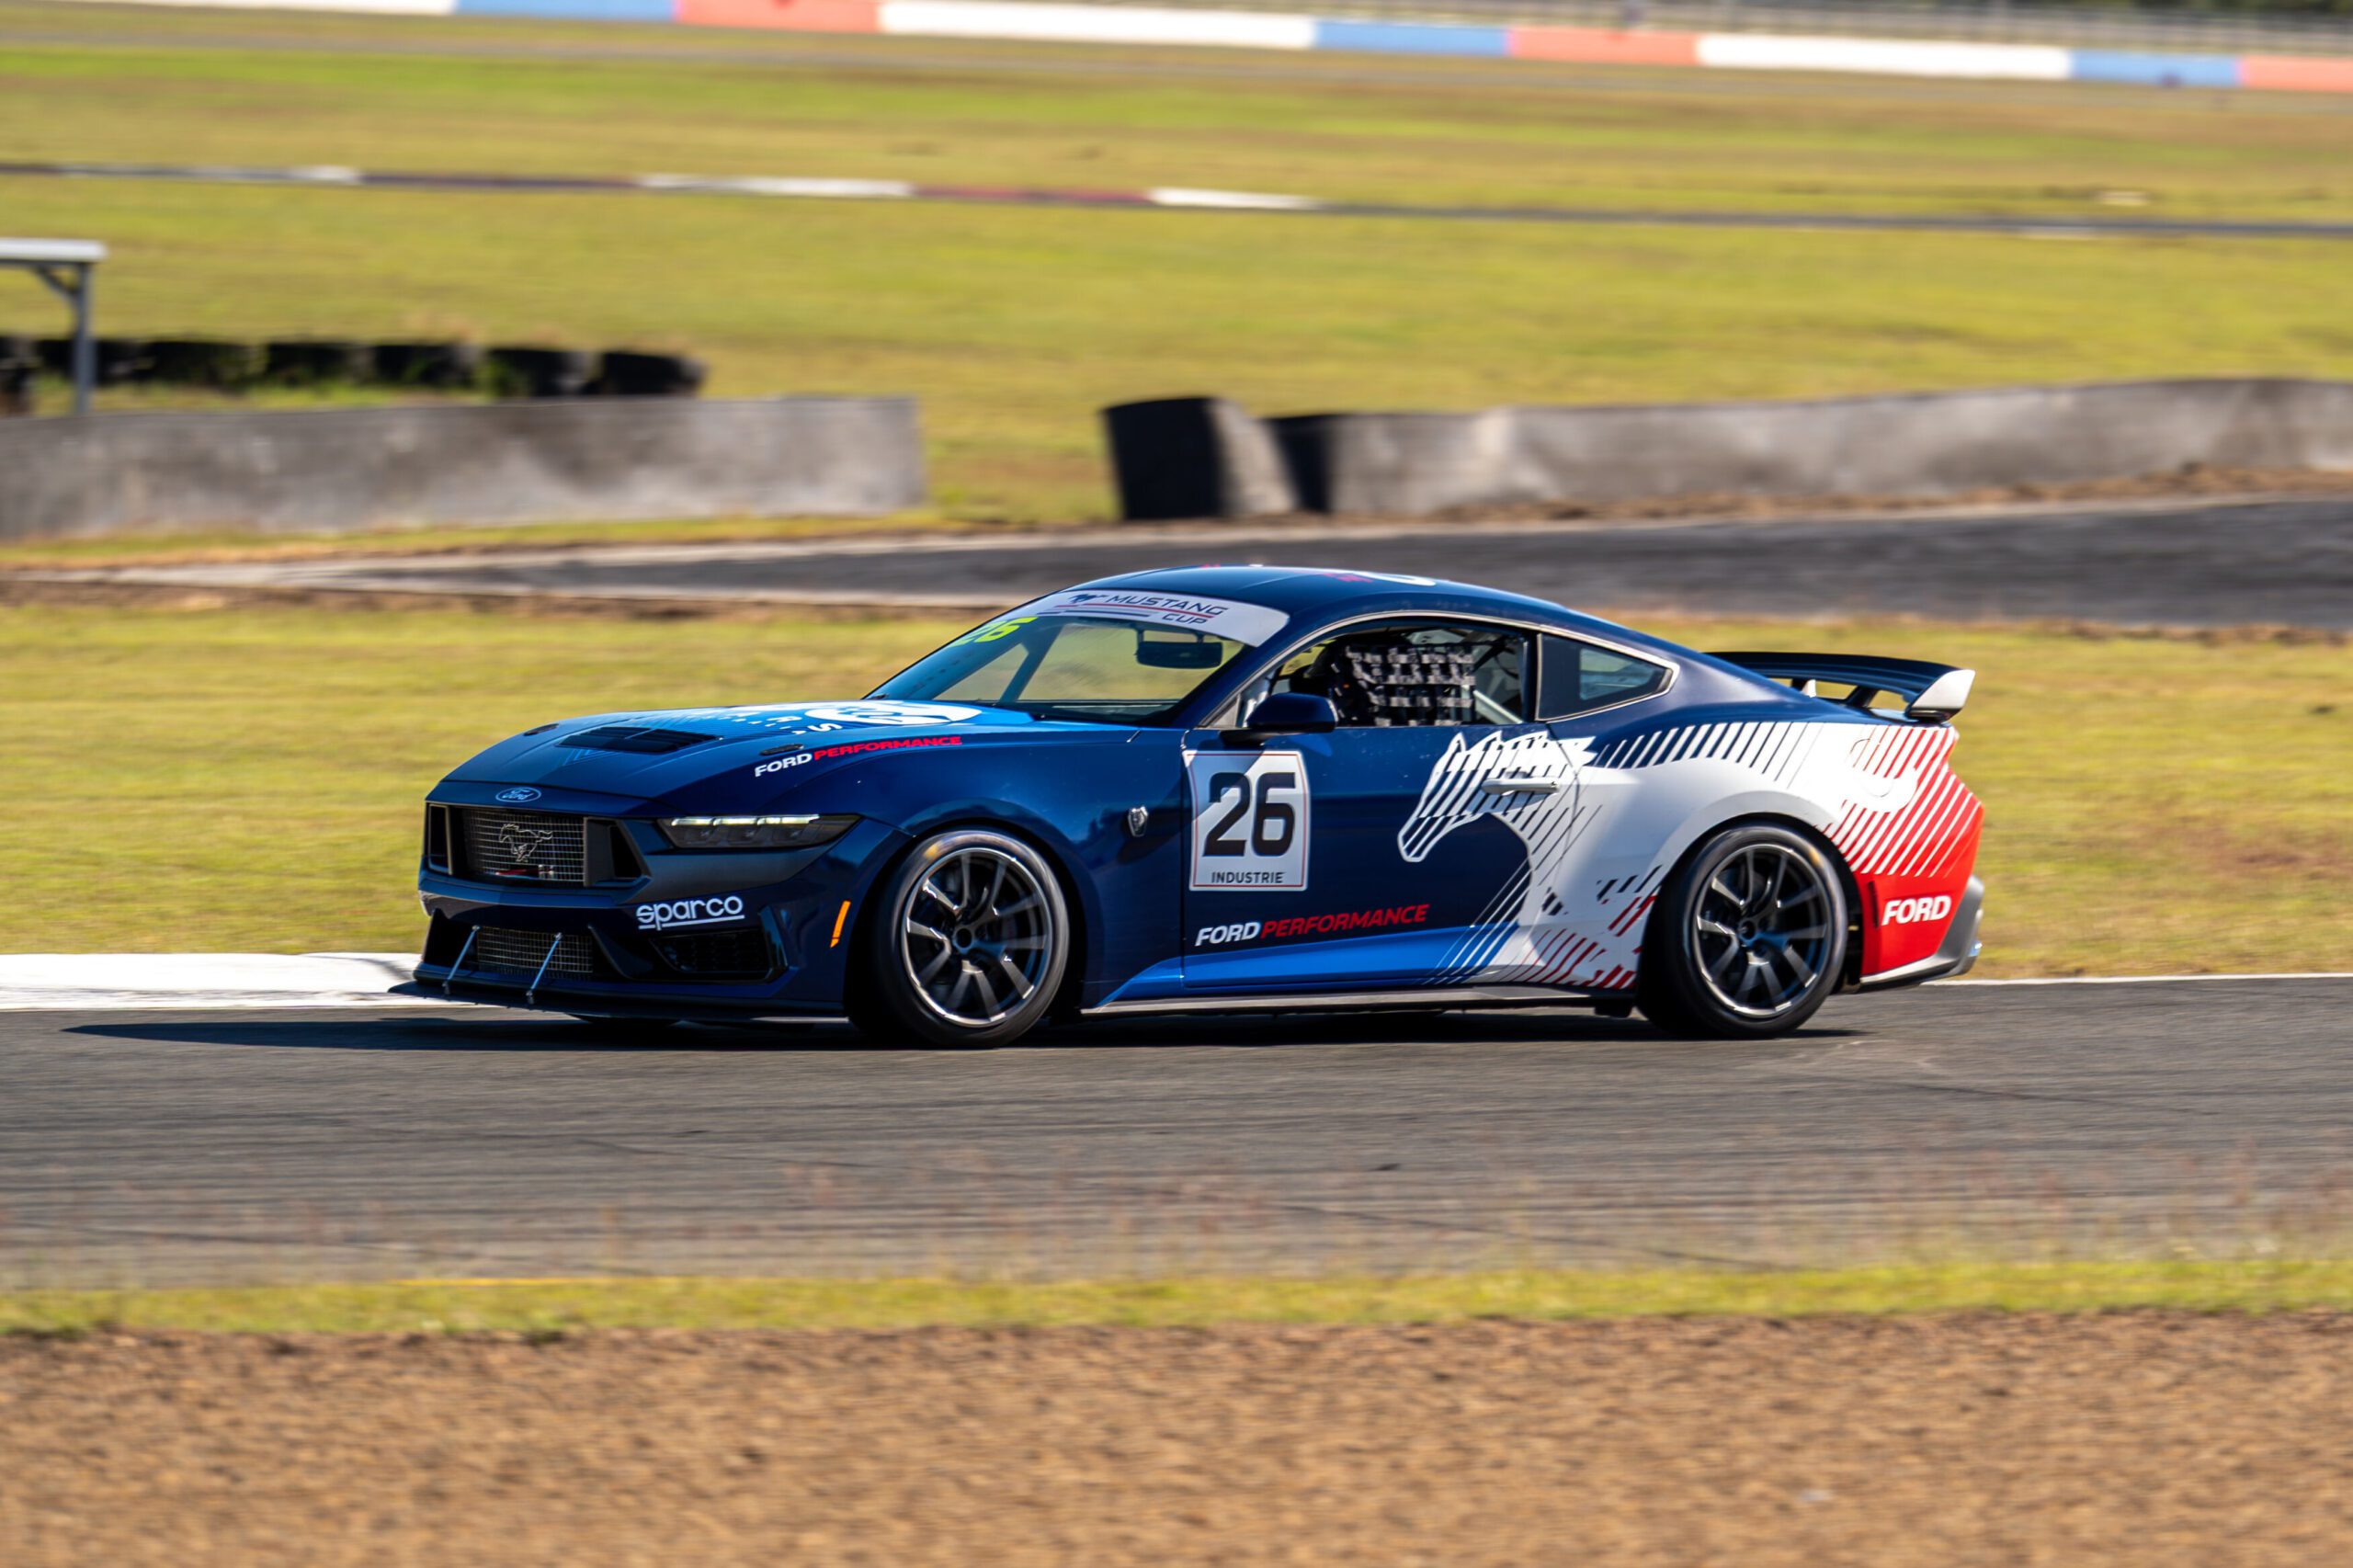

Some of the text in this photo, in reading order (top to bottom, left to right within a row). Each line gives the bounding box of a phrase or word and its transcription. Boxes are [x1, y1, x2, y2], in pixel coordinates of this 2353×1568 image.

[1103, 594, 1228, 616] MUSTANG
[1161, 613, 1209, 626] CUP
[754, 736, 962, 777] FORD PERFORMANCE
[1202, 772, 1296, 857] 26
[1211, 871, 1285, 883] INDUSTRIE
[636, 895, 744, 931] sparco
[1194, 904, 1430, 947] FORD PERFORMANCE
[1881, 894, 1952, 926] FORD
